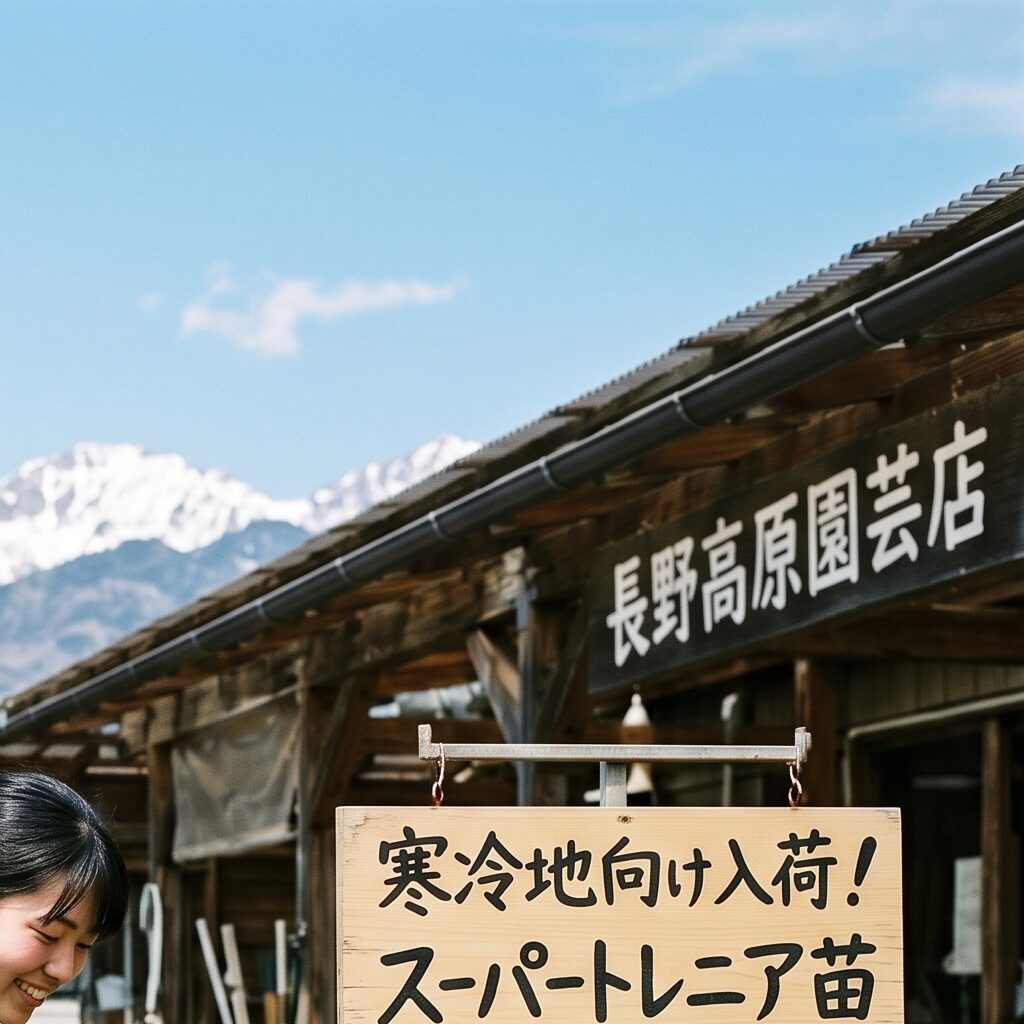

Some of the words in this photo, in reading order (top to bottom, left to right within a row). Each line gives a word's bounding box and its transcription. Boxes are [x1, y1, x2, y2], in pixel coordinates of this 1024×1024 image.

[606, 420, 988, 667] 長野高原園芸店
[378, 826, 877, 917] 寒冷地向け入荷!
